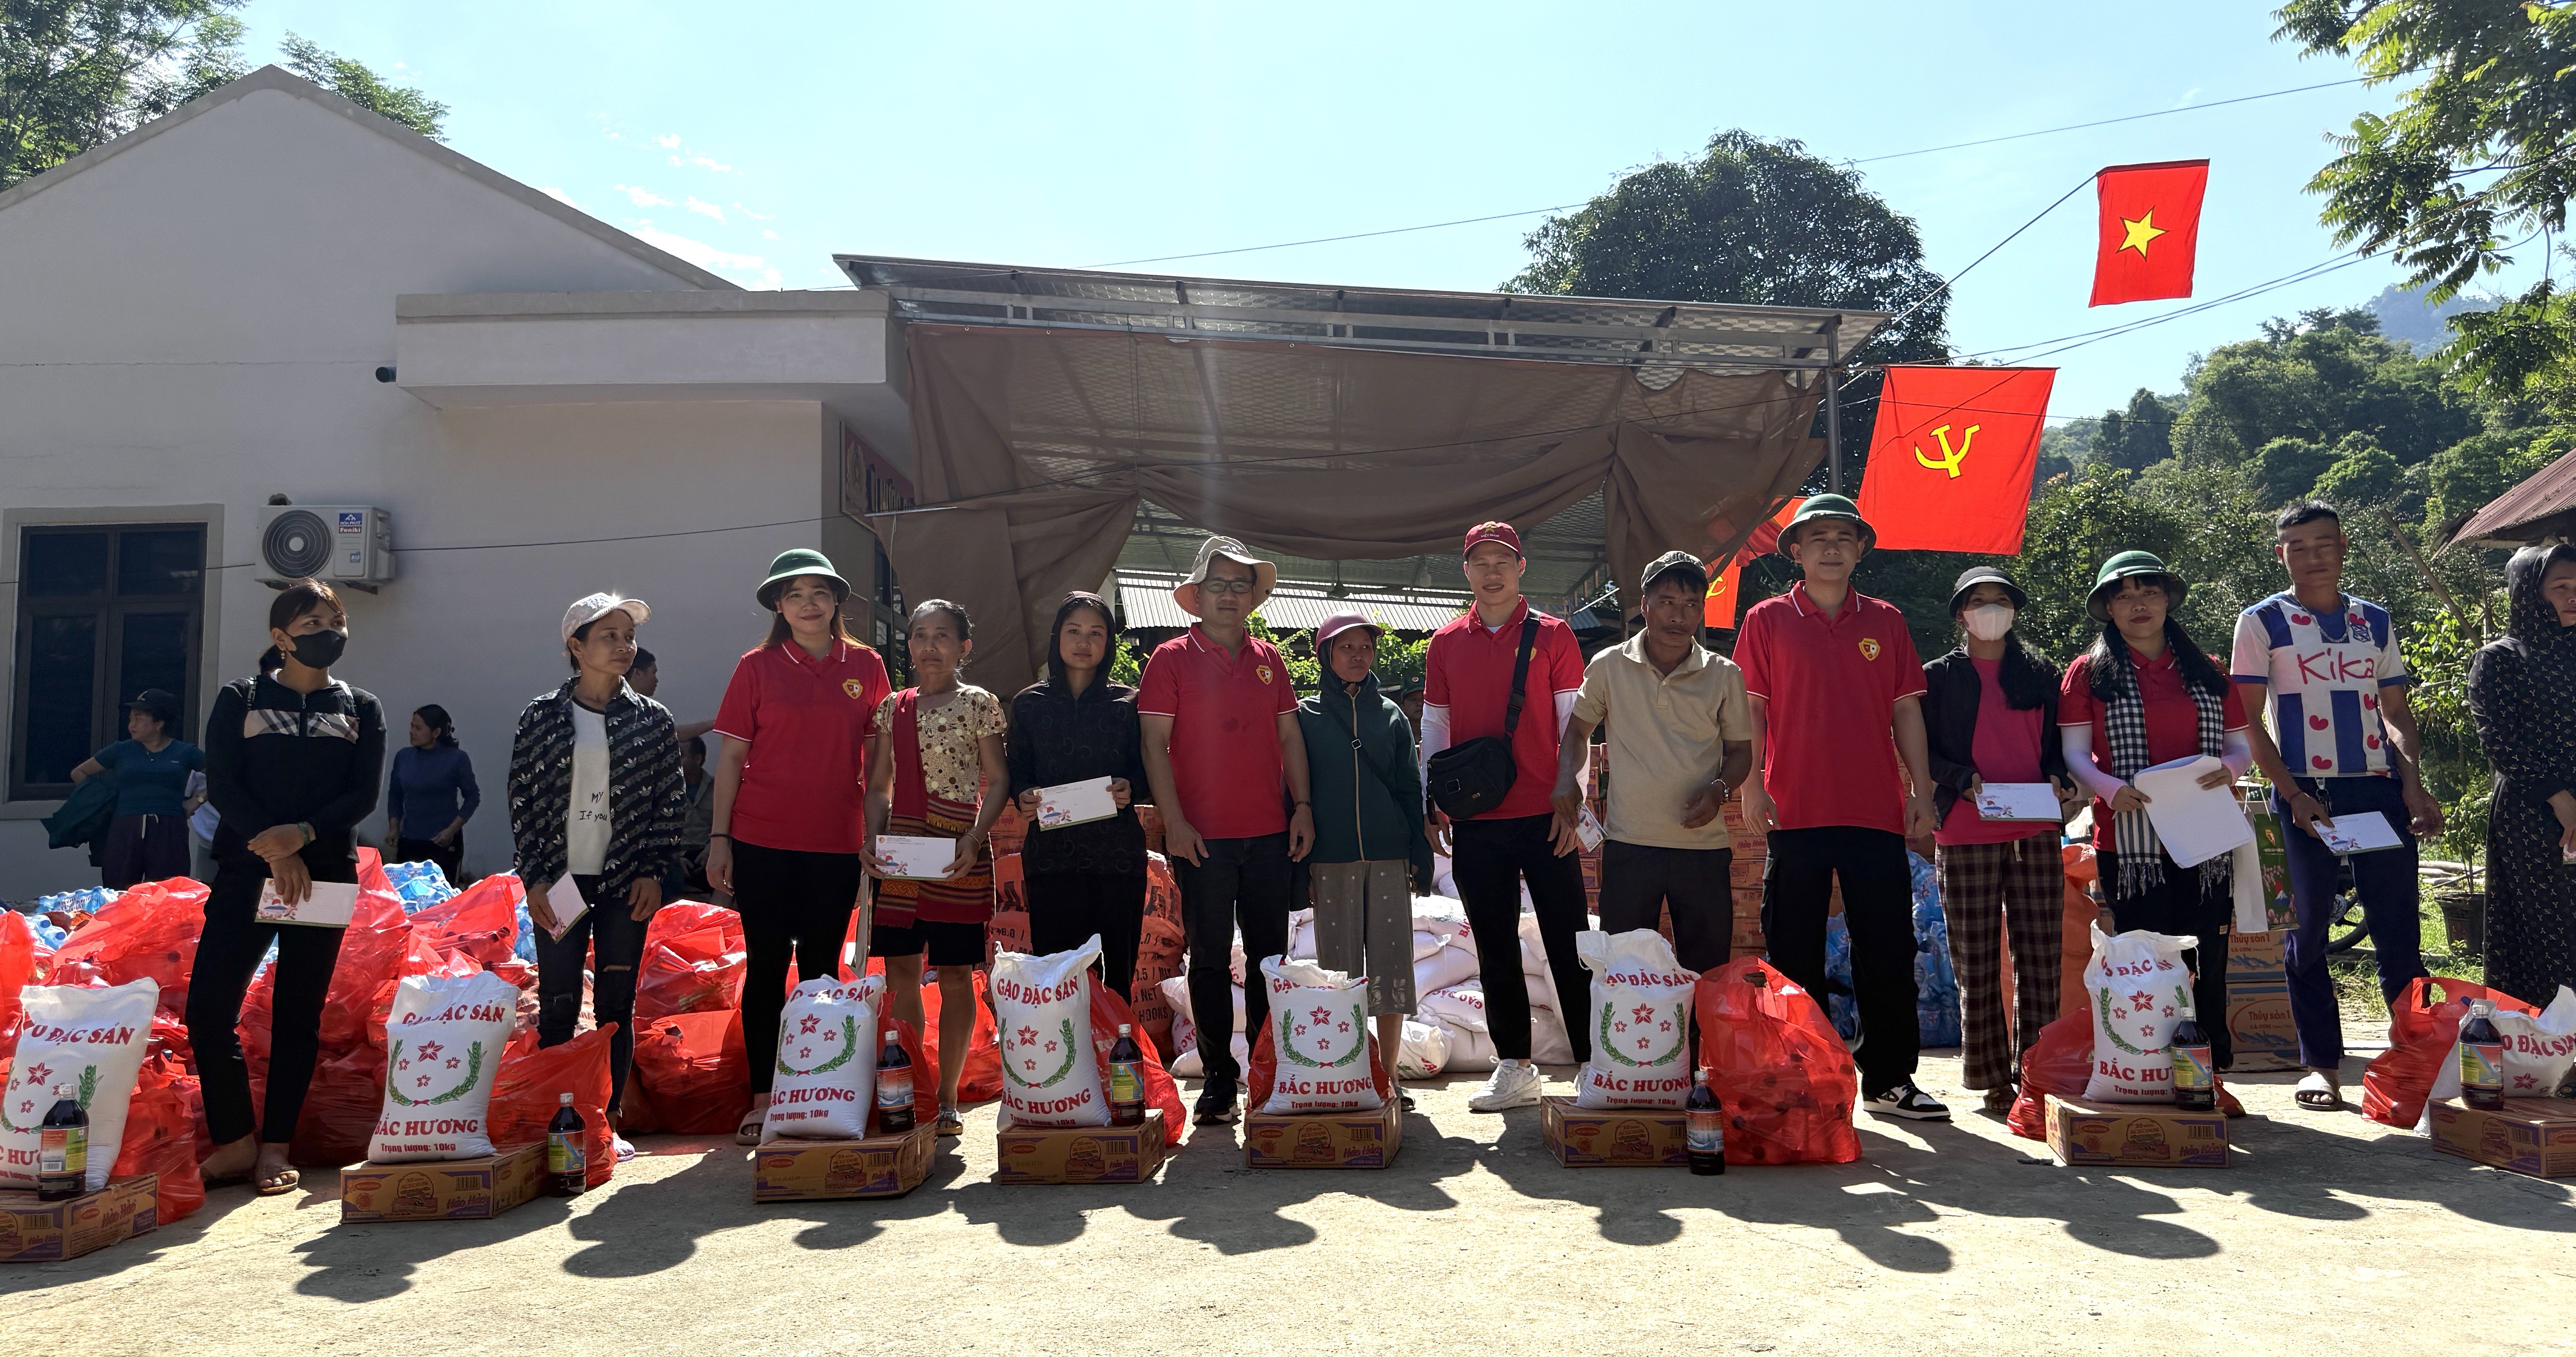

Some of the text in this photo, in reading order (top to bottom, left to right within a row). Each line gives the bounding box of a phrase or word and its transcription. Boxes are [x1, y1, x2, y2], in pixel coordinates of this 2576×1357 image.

[2297, 648, 2375, 684] Kika
[2250, 933, 2265, 943] sản
[1604, 968, 1694, 988] ẠO ĐẶC SẢN
[2116, 959, 2153, 977] ĐẶC
[997, 978, 1020, 1001] GẠO
[1022, 984, 1051, 1009] ĐẶC
[1140, 988, 1158, 1002] NET
[470, 999, 506, 1023] SẢN
[1139, 1007, 1168, 1023] HOOKS
[2100, 1058, 2135, 1082] BẮC
[1279, 1074, 1372, 1095] BẮC HƯƠNG
[1593, 1071, 1690, 1092] BẮC HƯƠNG
[770, 1086, 855, 1107] ẮC HƯƠNG
[1002, 1088, 1091, 1114] BẮC HƯƠNG
[810, 1109, 829, 1118] 10kg
[374, 1113, 479, 1136] BẮC HƯƠNG
[381, 1143, 456, 1153] Trọng lượng: 10kg
